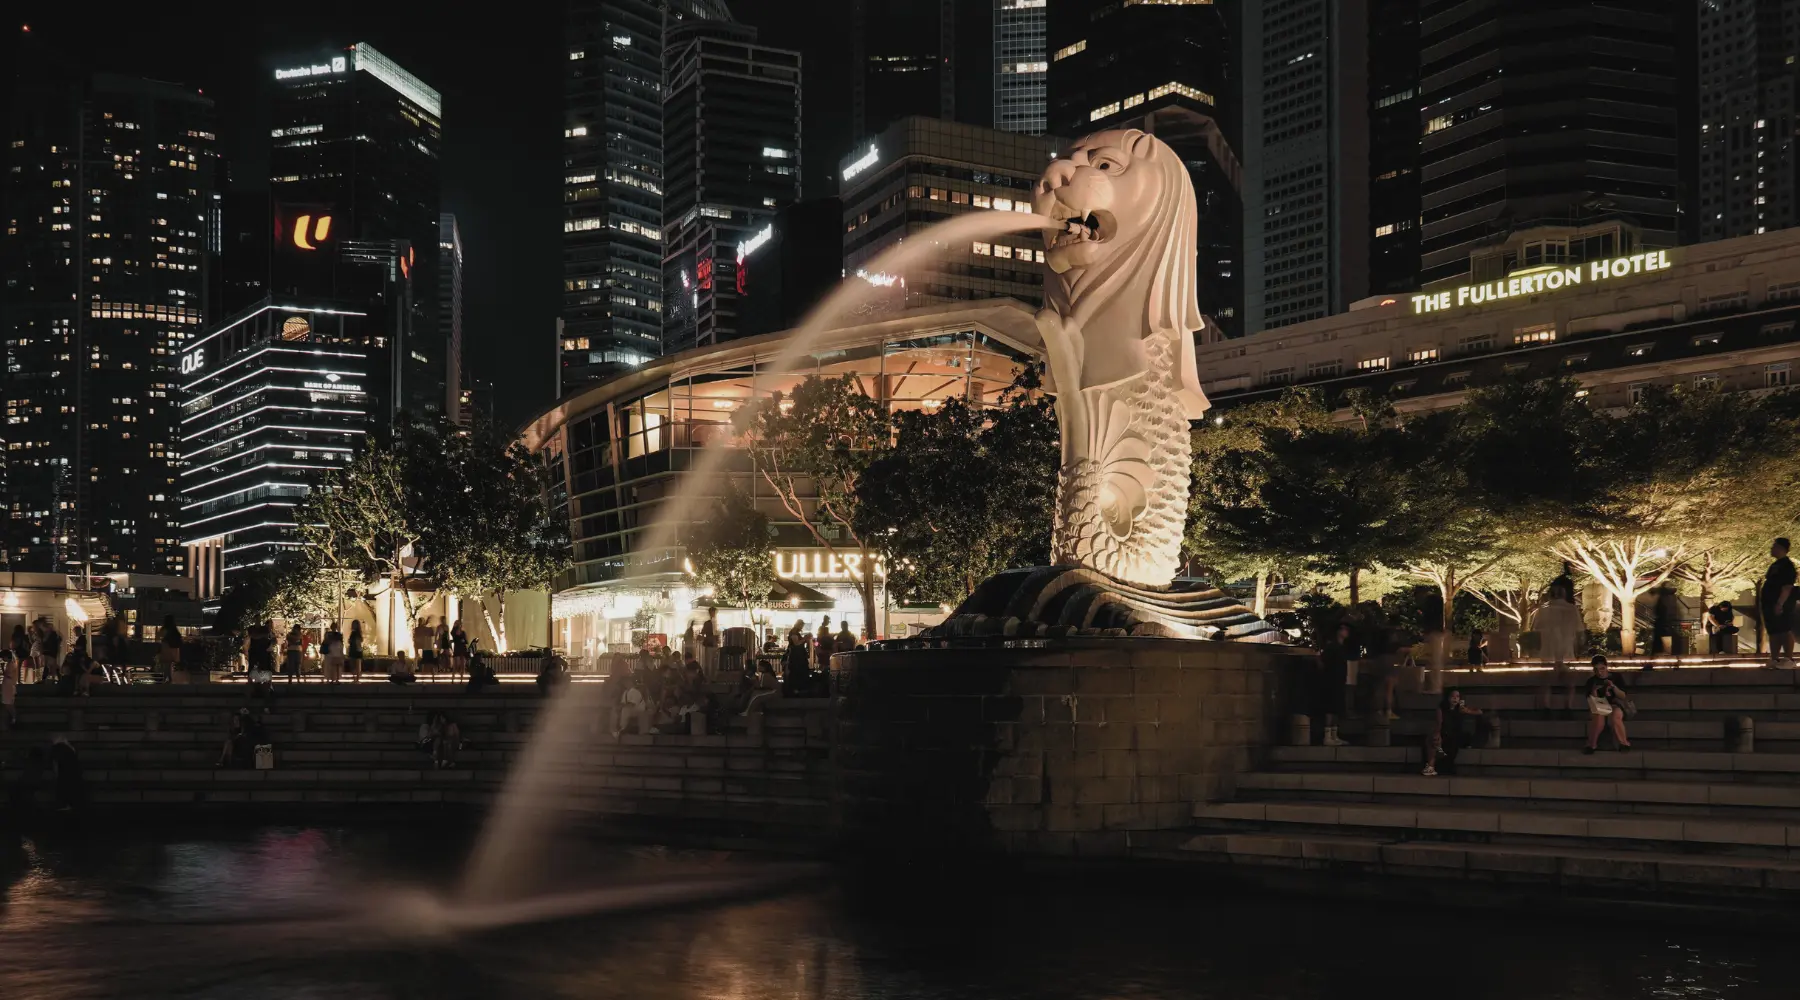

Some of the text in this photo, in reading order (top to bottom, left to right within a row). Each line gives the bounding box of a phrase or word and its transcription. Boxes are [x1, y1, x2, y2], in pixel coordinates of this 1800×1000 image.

[1411, 250, 1671, 314] THE FULLERTON HOTEL
[181, 348, 205, 375] OUE
[768, 550, 886, 578] ULLER
[767, 600, 799, 609] BURGER
